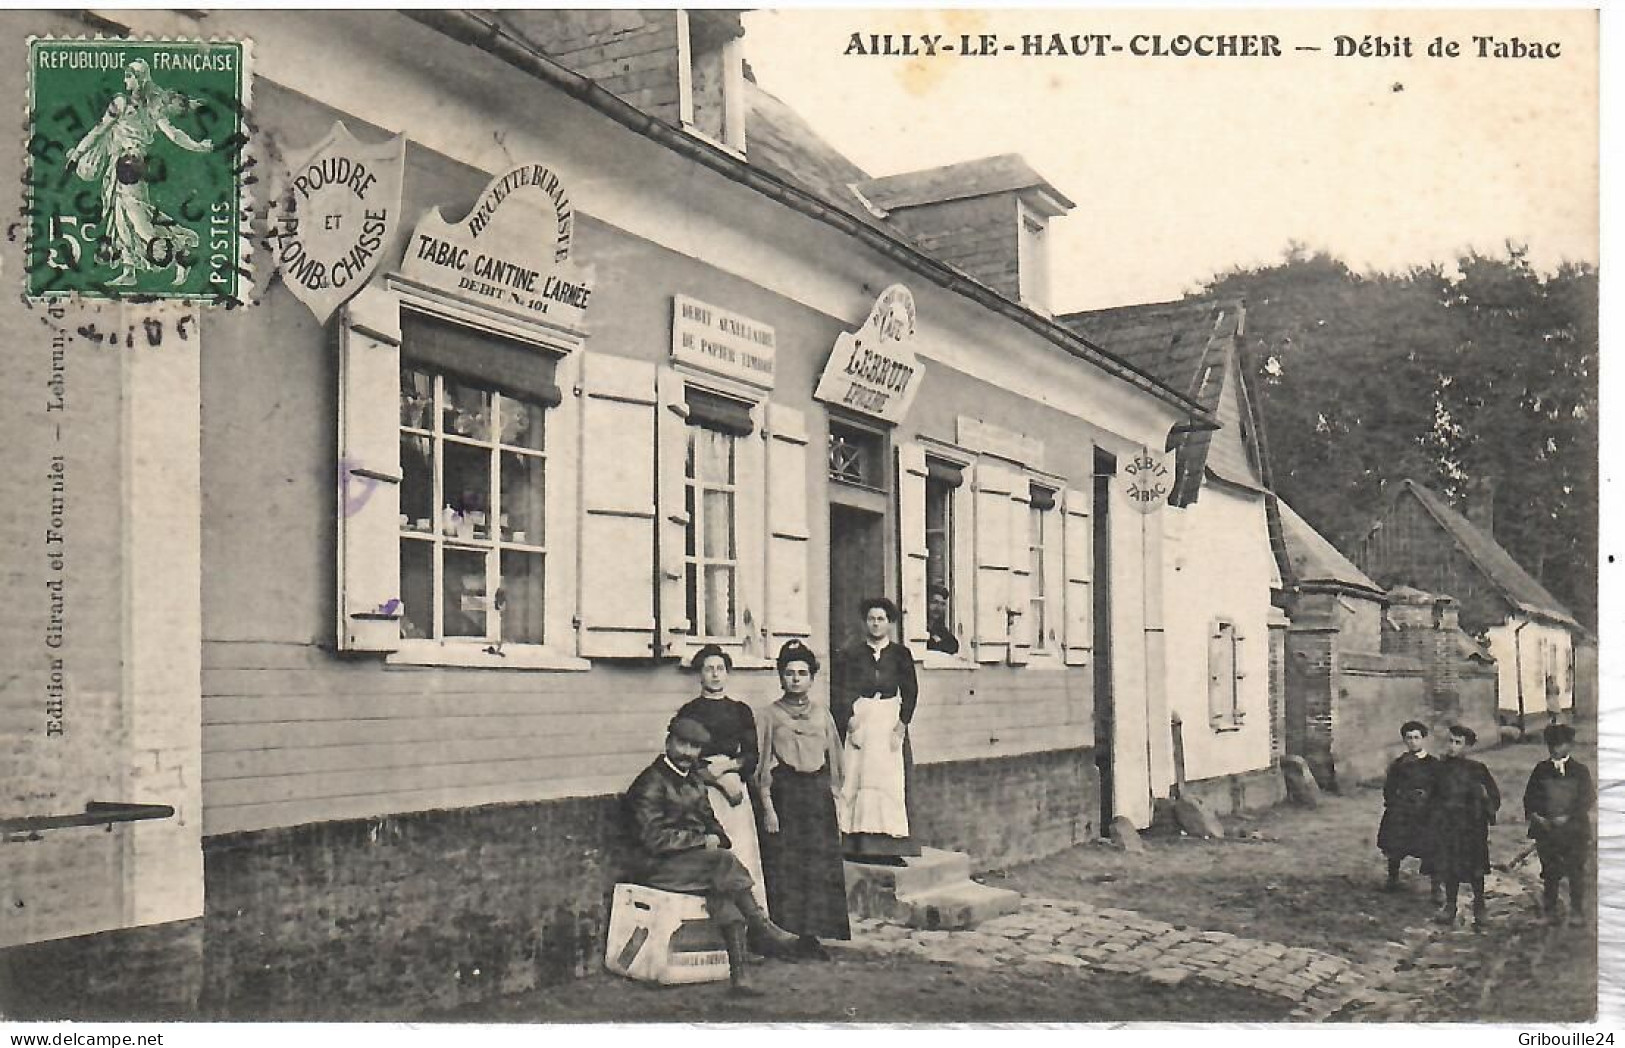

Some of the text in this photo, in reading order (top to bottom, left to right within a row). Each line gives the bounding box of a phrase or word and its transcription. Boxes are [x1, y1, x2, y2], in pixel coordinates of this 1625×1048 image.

[153, 52, 232, 73] FRANÇAISE
[294, 157, 377, 200] POUDRE
[325, 215, 342, 230] ET
[469, 164, 571, 264] RECETTE BURALISTE
[209, 200, 230, 284] POSTES
[277, 217, 326, 290] PLOMB
[331, 208, 386, 289] CHASSE
[417, 234, 592, 310] TABAC CANTINE L'ARMÉE
[458, 277, 507, 300] DEBIT
[528, 300, 549, 314] 101
[1126, 483, 1166, 501] TABAC
